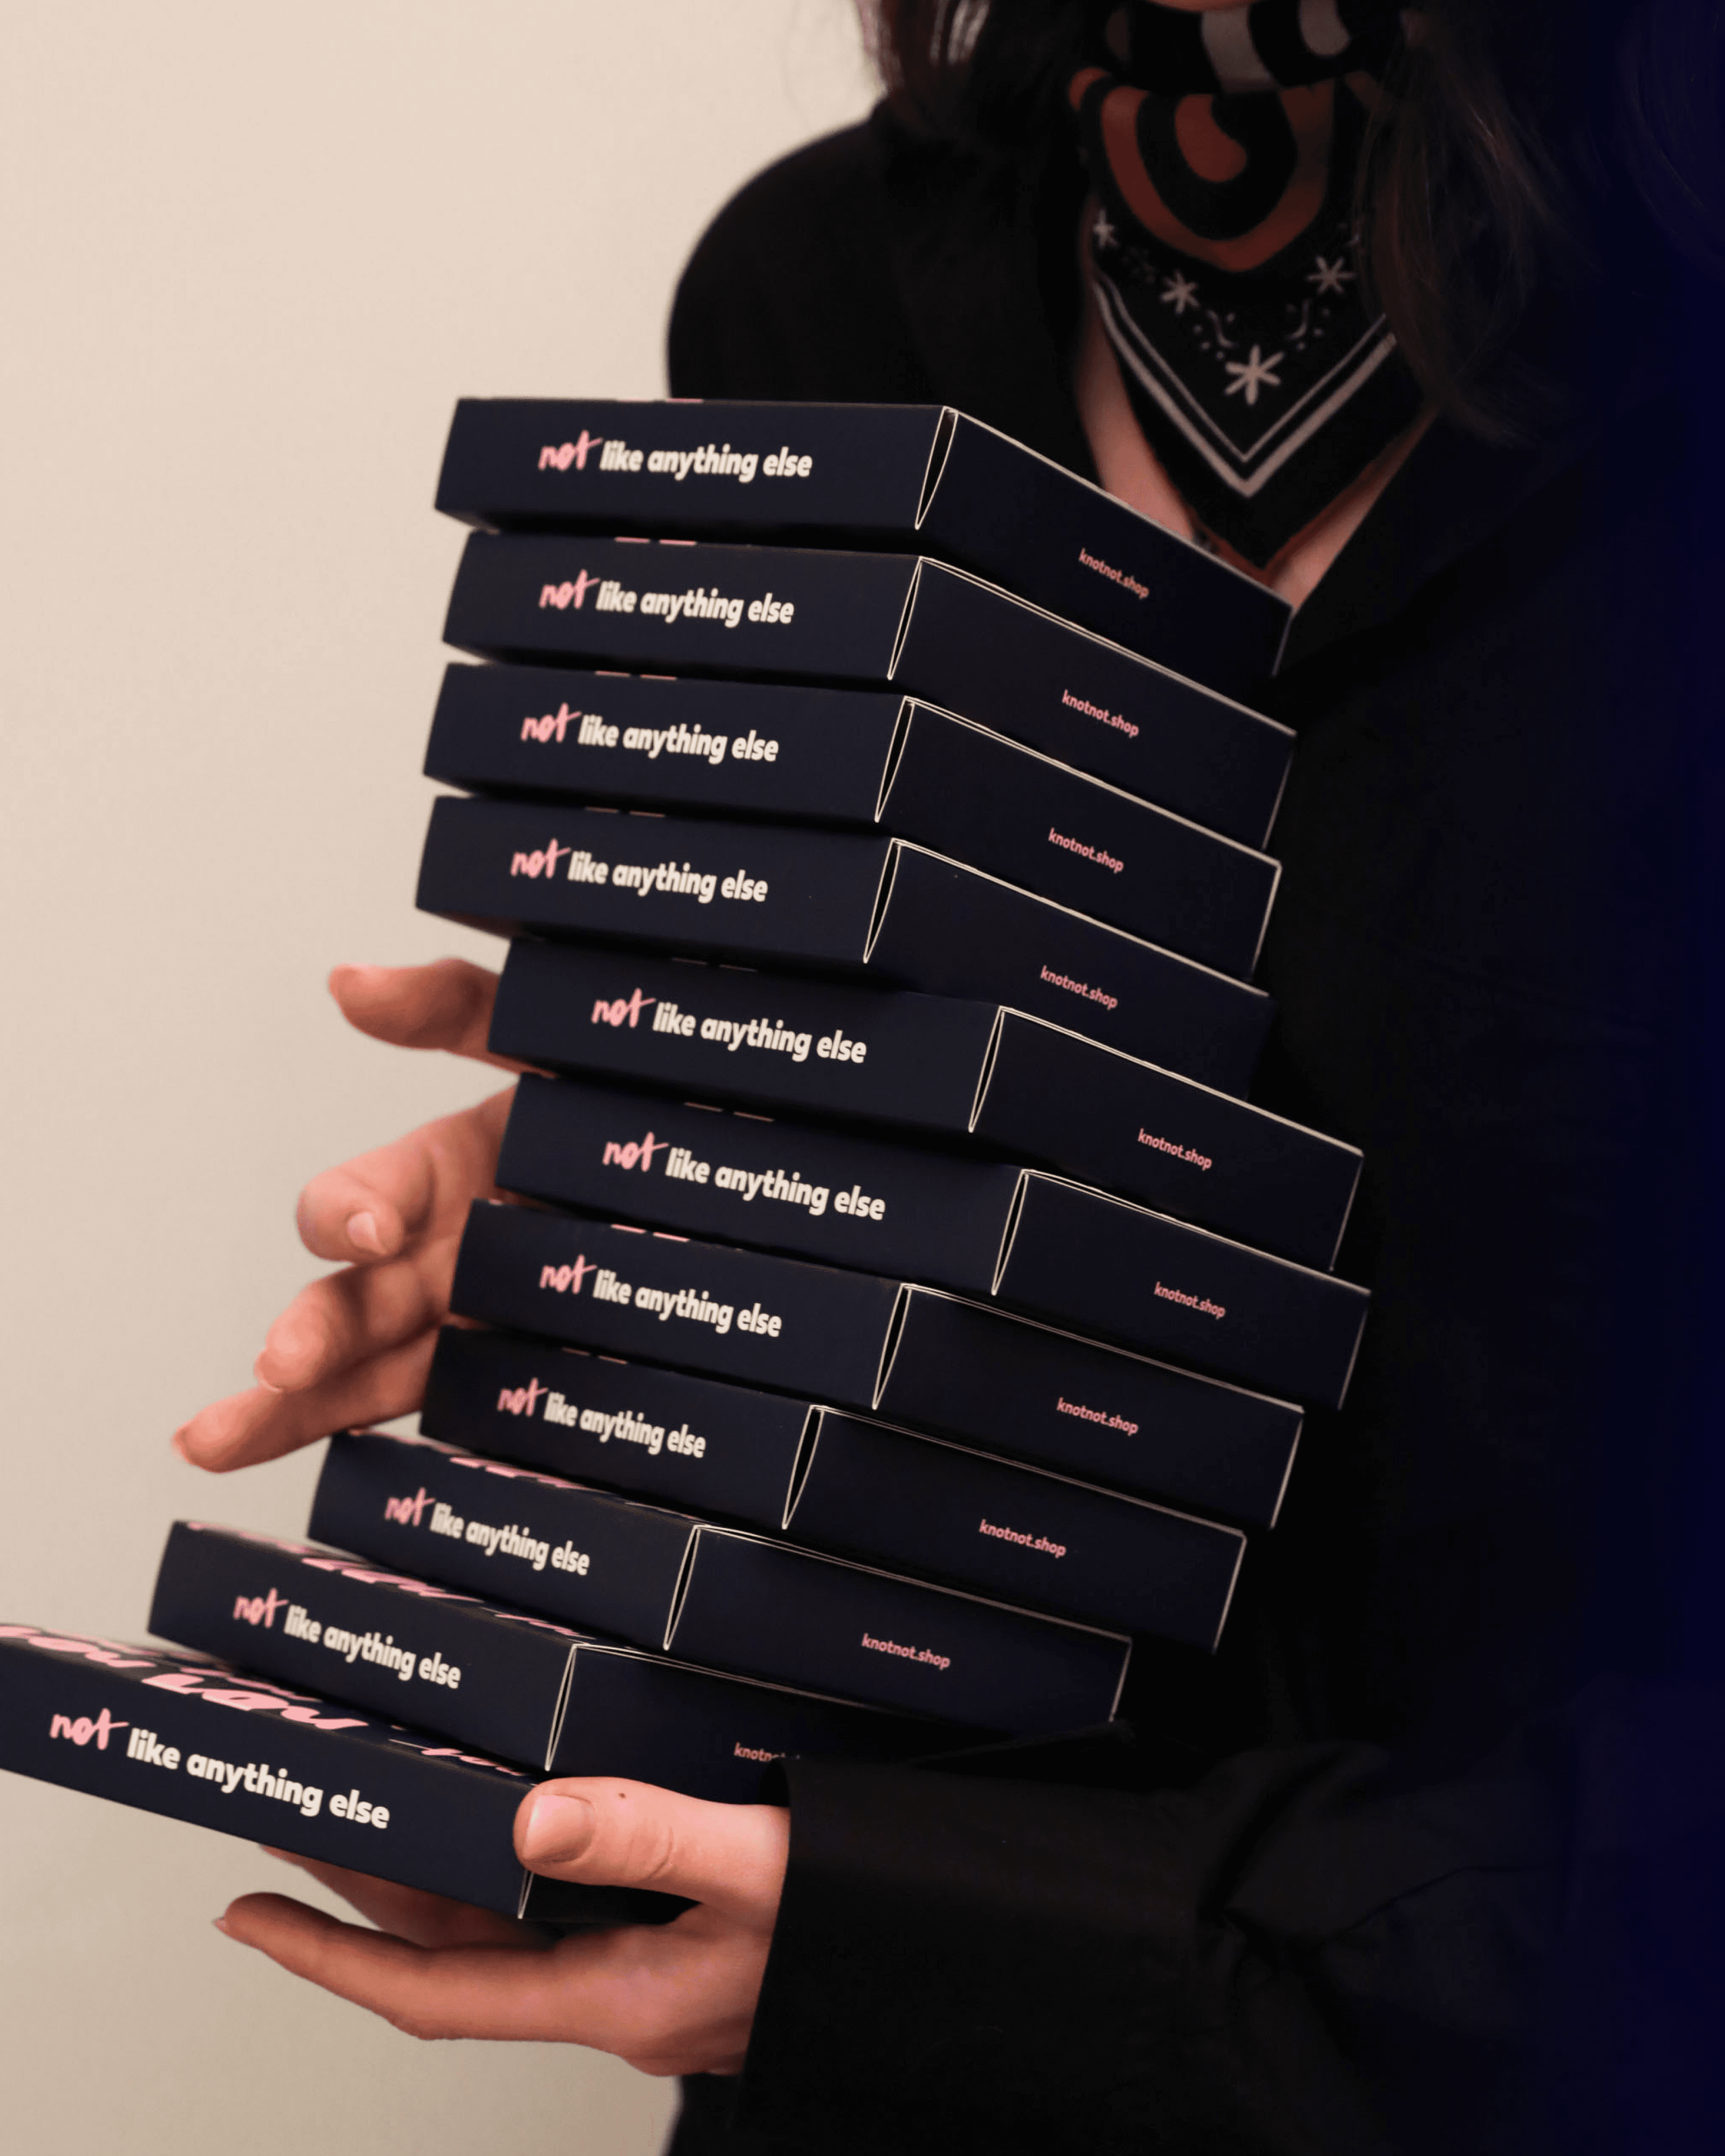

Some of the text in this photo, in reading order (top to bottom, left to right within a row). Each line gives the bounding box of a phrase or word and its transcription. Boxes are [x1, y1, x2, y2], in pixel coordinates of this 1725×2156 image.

[538, 430, 813, 484] not like anything else
[539, 569, 795, 629] not like anything else
[1078, 548, 1149, 599] knotnot.shop
[520, 702, 779, 766] not like anything else
[1062, 689, 1139, 738] knotnot.shop
[510, 838, 769, 904] not like anything else
[1048, 827, 1124, 874] knotnot.shop
[1040, 965, 1118, 1011] knotnot.shop
[590, 988, 867, 1064] not like anything else
[602, 1131, 886, 1221] not like anything else
[1137, 1127, 1213, 1171] knotnot.shop
[539, 1254, 783, 1338] not like anything else
[1154, 1280, 1226, 1319] knotnot.shop
[497, 1377, 707, 1459] not like anything else
[1056, 1396, 1139, 1436] knotnot.shop
[384, 1487, 590, 1576] not like anything else
[979, 1519, 1066, 1559] knotnot.shop
[233, 1588, 462, 1690] not like anything else
[861, 1633, 950, 1671] knotnot.shop
[49, 1707, 390, 1829] not like anything else
